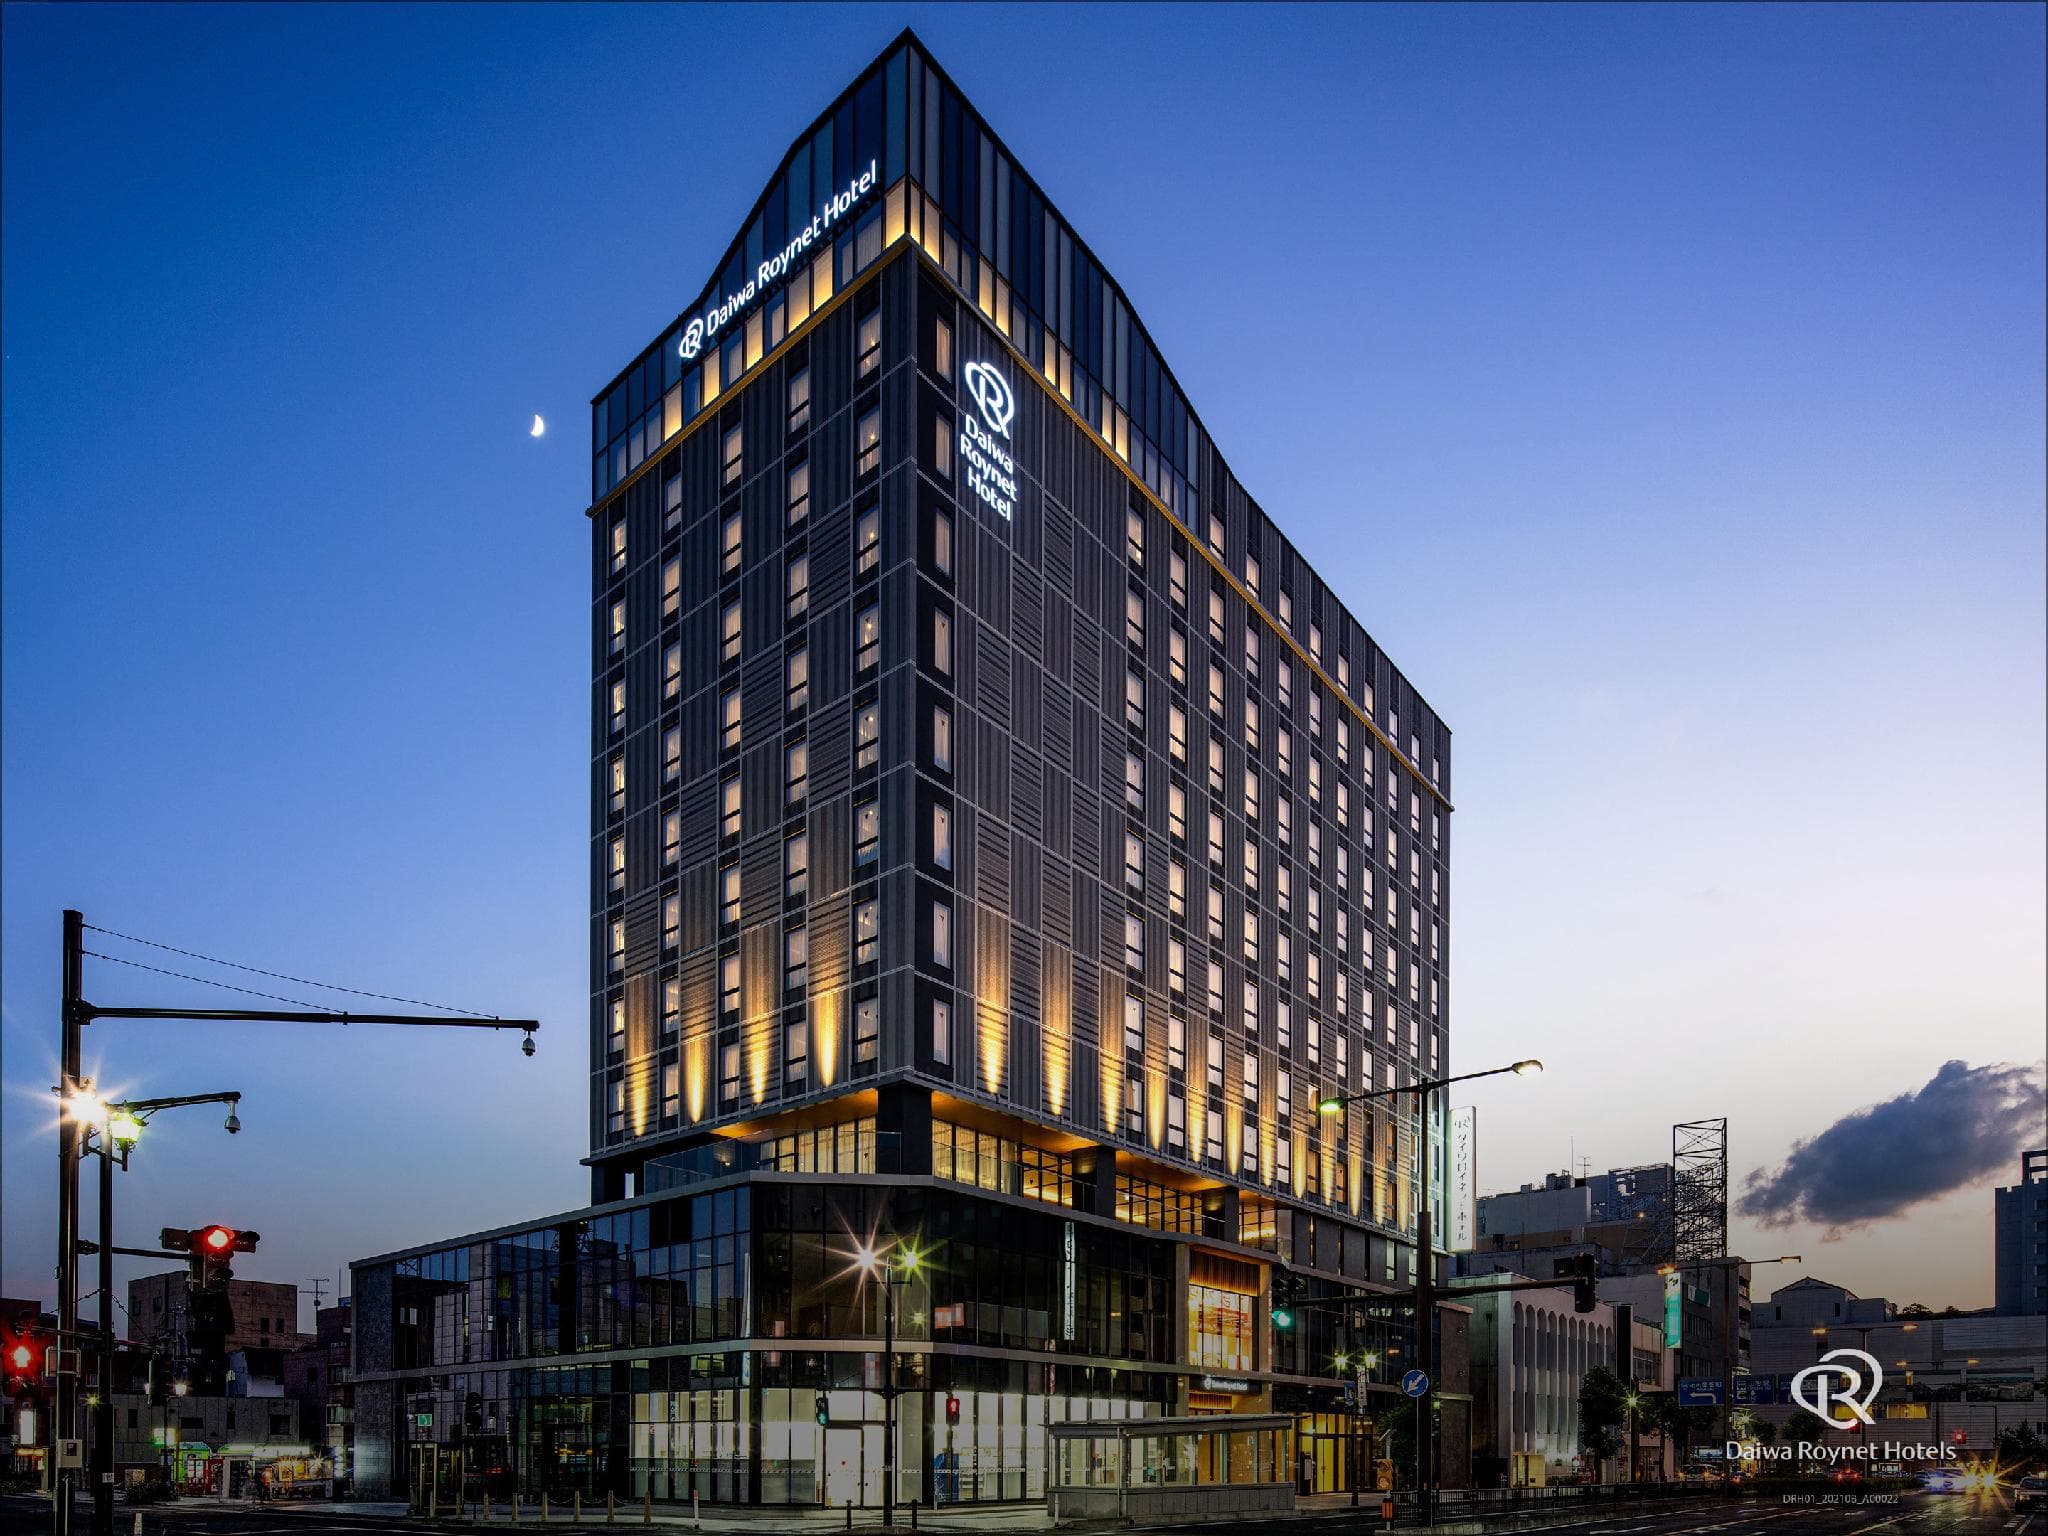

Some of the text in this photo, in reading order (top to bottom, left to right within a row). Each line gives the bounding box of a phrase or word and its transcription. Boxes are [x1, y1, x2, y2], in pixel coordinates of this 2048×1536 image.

[707, 280, 755, 337] Daiwa
[758, 215, 821, 289] Roynet
[824, 159, 876, 227] Hotel
[960, 433, 1017, 502] Roynet
[965, 414, 1014, 475] Daiwa
[967, 466, 1011, 521] Hotel
